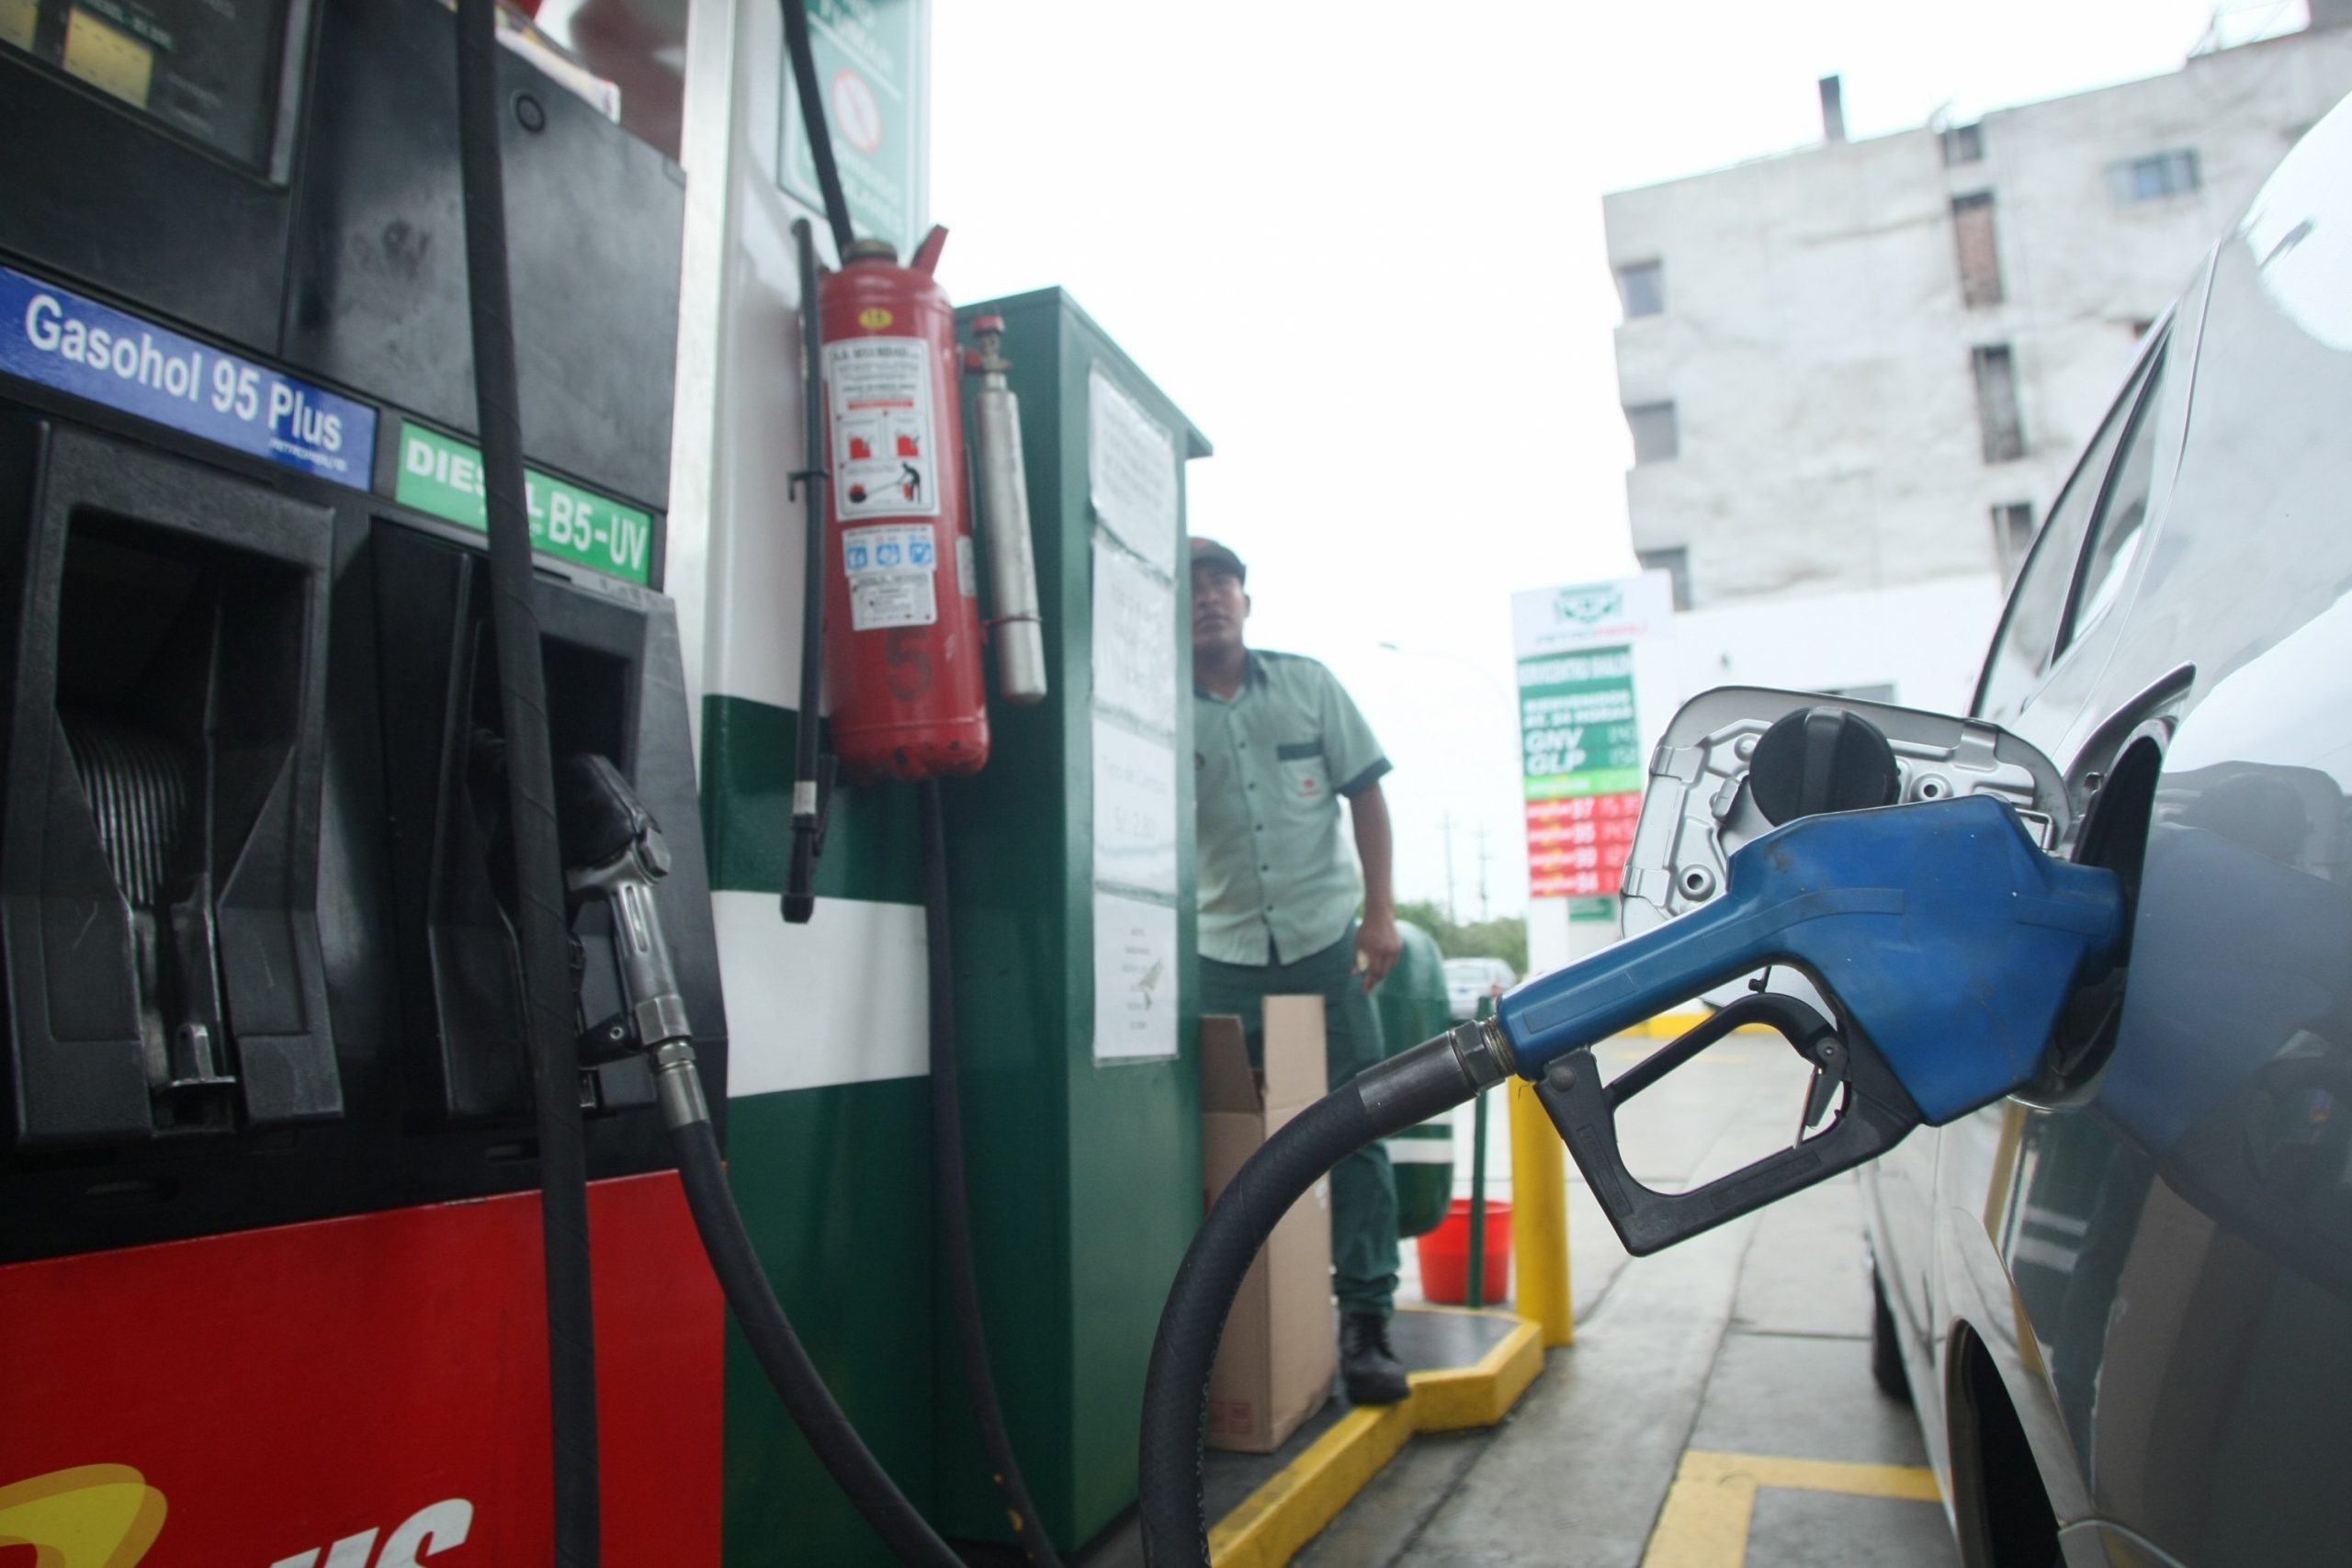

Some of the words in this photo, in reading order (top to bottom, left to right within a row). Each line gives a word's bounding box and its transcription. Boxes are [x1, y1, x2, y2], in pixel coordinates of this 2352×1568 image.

[26, 294, 202, 401] Gasohol
[211, 359, 260, 422] 95
[268, 381, 343, 451] Plus
[548, 491, 649, 570] B5-UV
[1525, 727, 1584, 753] GNV
[1526, 749, 1587, 775] GLP
